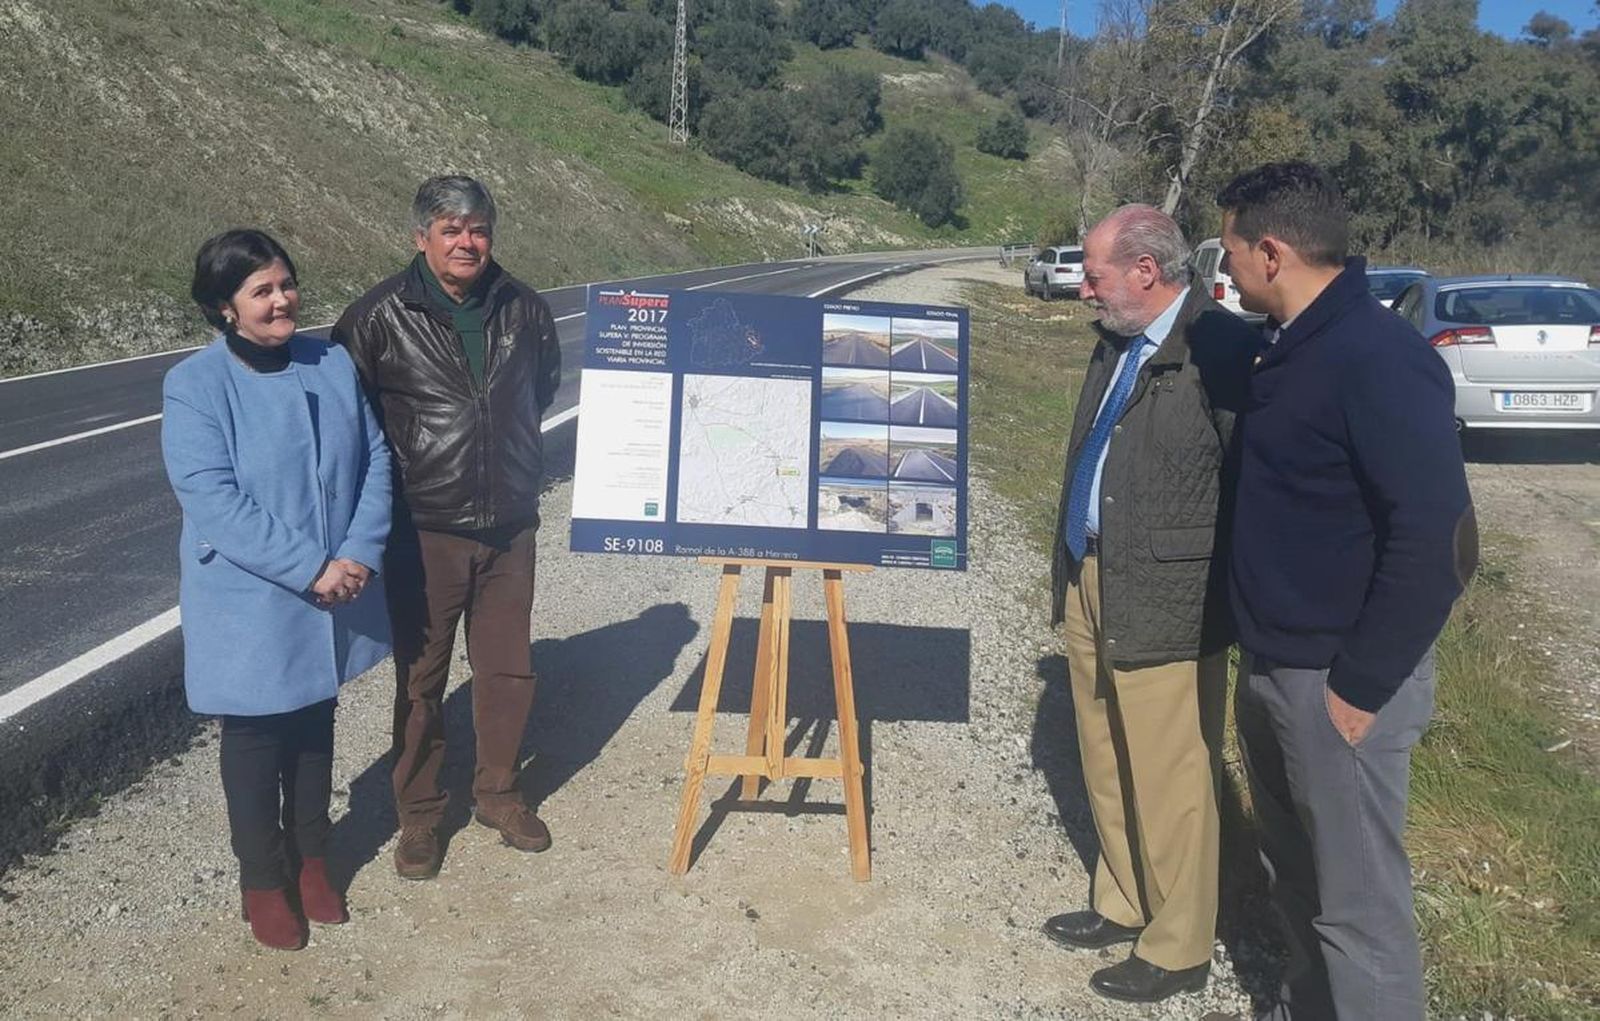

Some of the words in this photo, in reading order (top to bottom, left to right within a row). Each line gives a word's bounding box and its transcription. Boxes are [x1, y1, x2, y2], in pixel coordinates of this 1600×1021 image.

[628, 308, 668, 323] 2017
[630, 325, 667, 333] PROVINCIAL
[599, 331, 622, 339] SUPERA
[631, 333, 667, 341] PROGRAMA
[596, 347, 633, 356] SOSTENIBLE
[628, 357, 666, 365] PROVINCIAL
[1513, 394, 1547, 406] 0863
[1553, 394, 1579, 406] HZP
[604, 537, 664, 553] SE-9108
[704, 546, 715, 555] de
[718, 546, 726, 555] la
